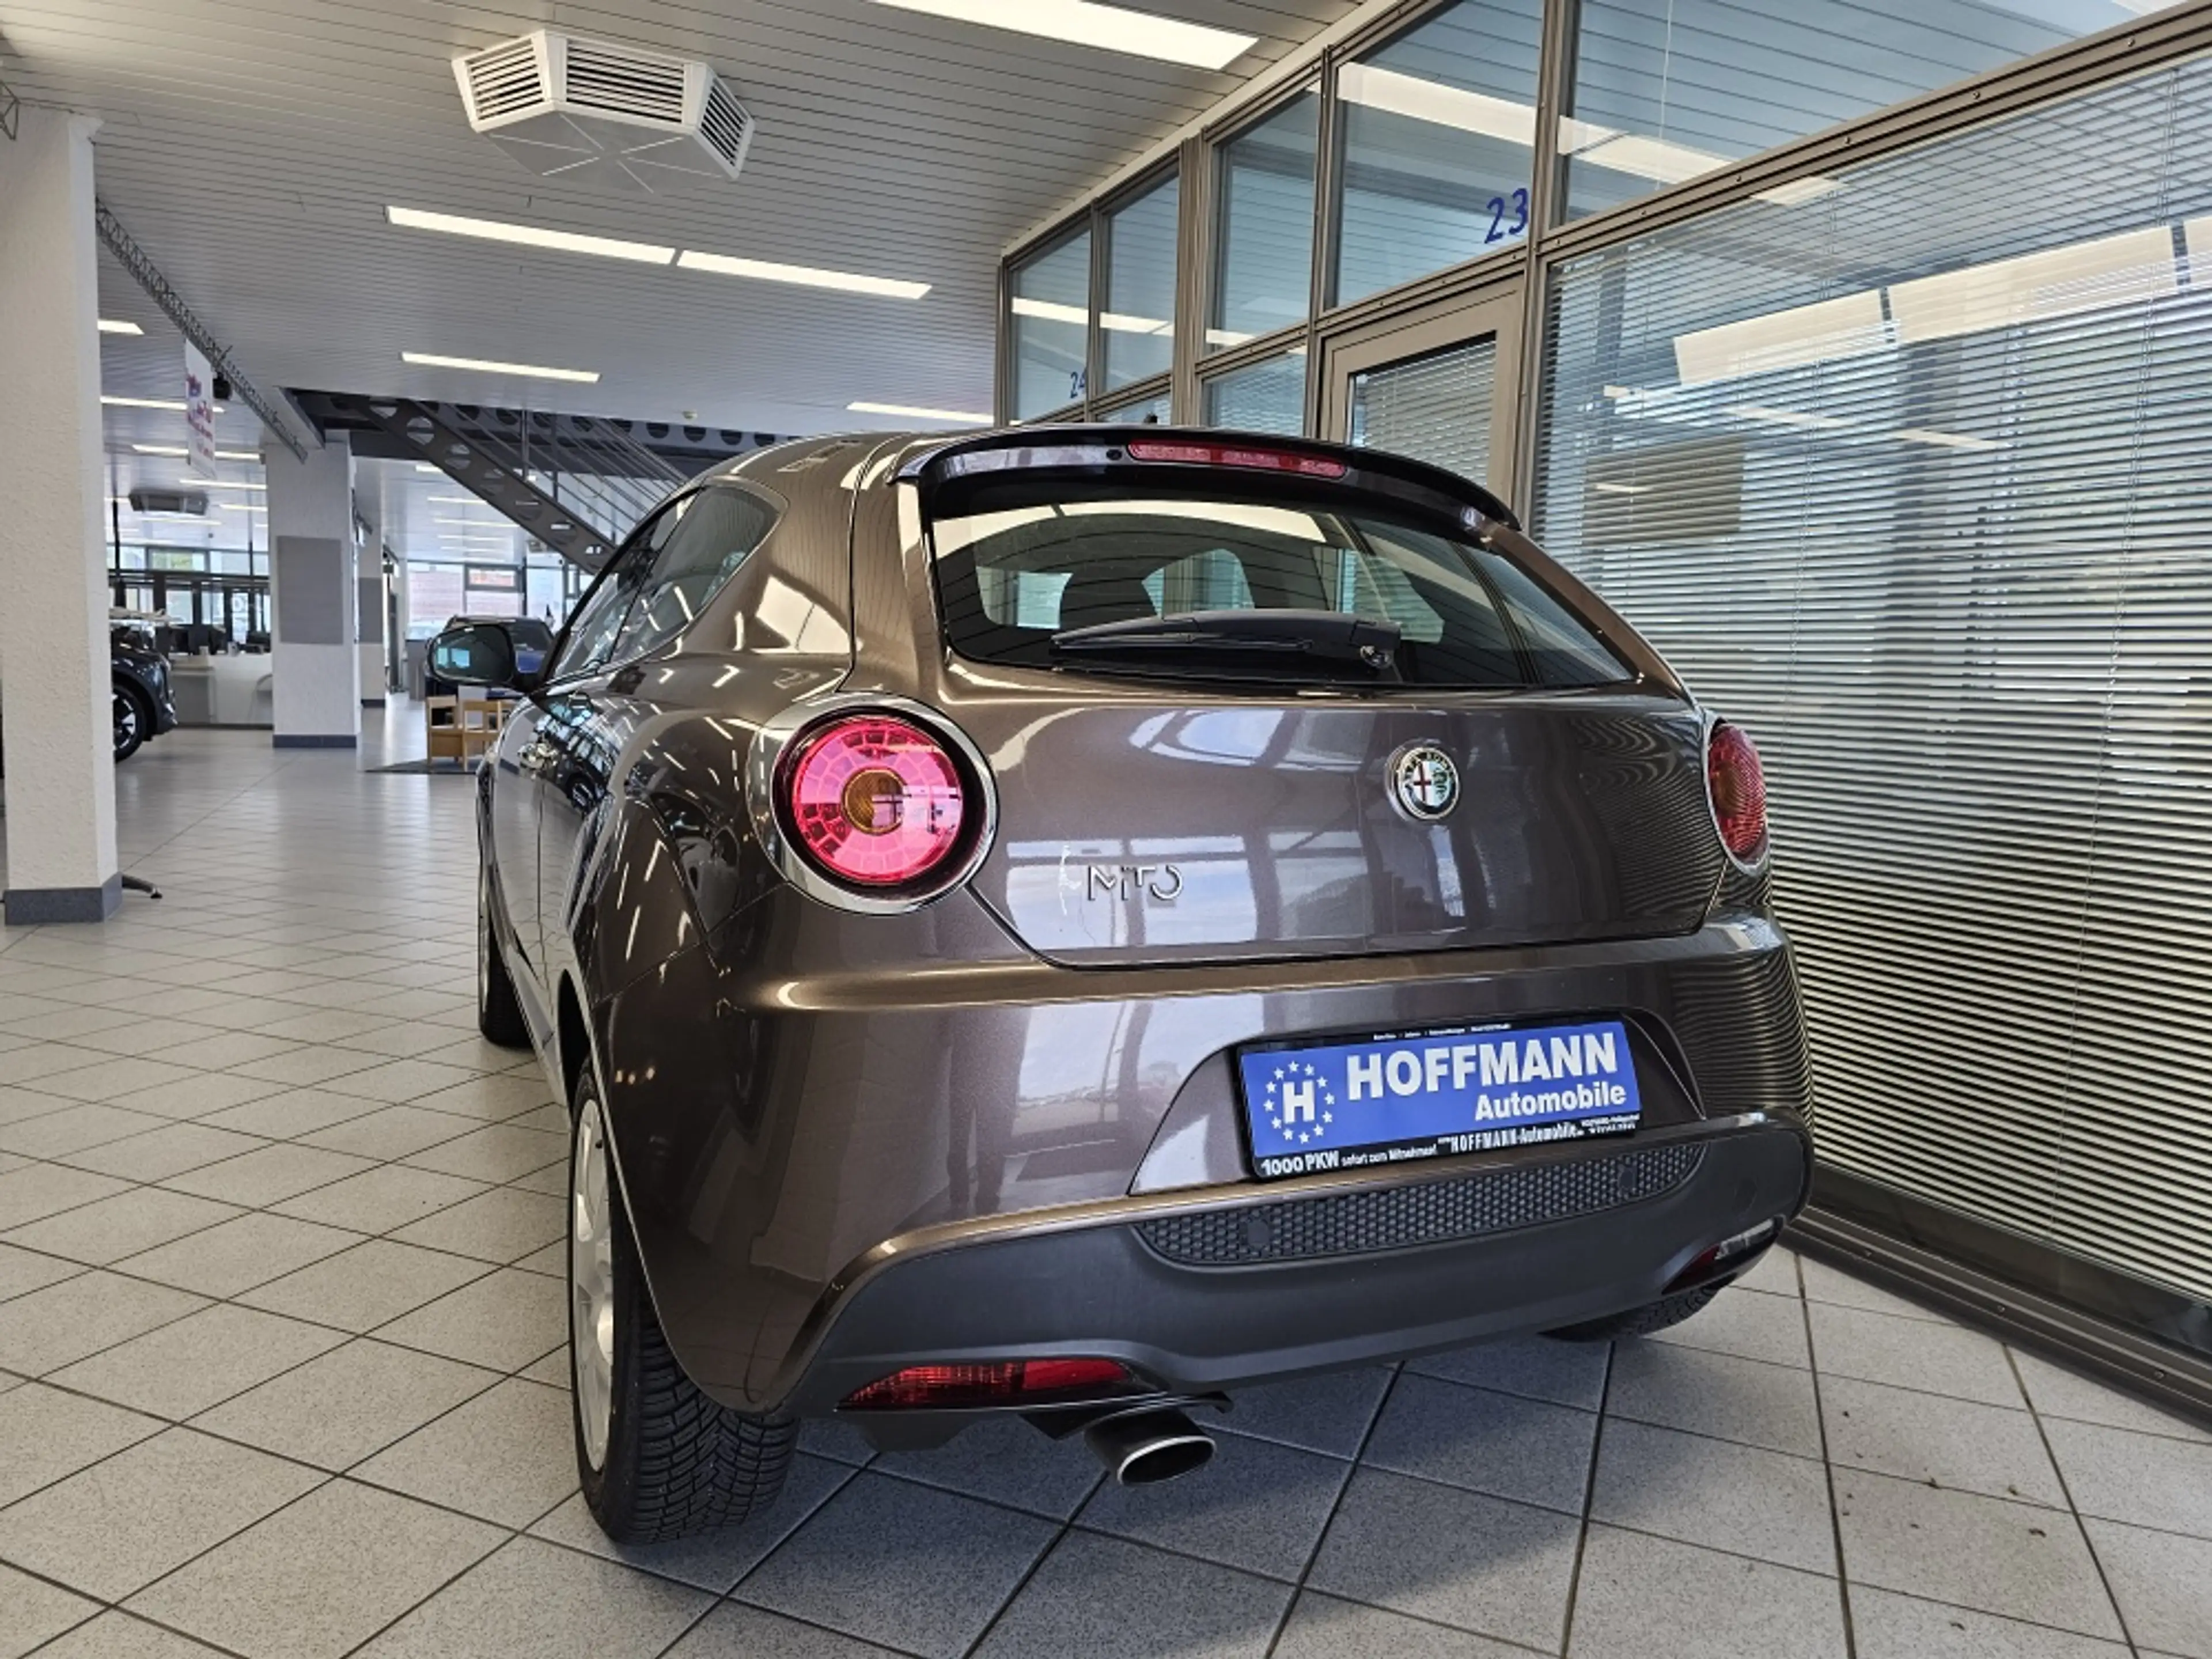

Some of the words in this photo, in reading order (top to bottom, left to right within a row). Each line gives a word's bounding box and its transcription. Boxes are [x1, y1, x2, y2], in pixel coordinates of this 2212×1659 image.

[1484, 188, 1528, 244] 23
[1347, 1032, 1617, 1101] HOFFMANN
[1283, 1080, 1315, 1124] H
[1475, 1081, 1627, 1121] Automobile
[1261, 1157, 1304, 1176] 1000
[1305, 1150, 1339, 1171] PKW
